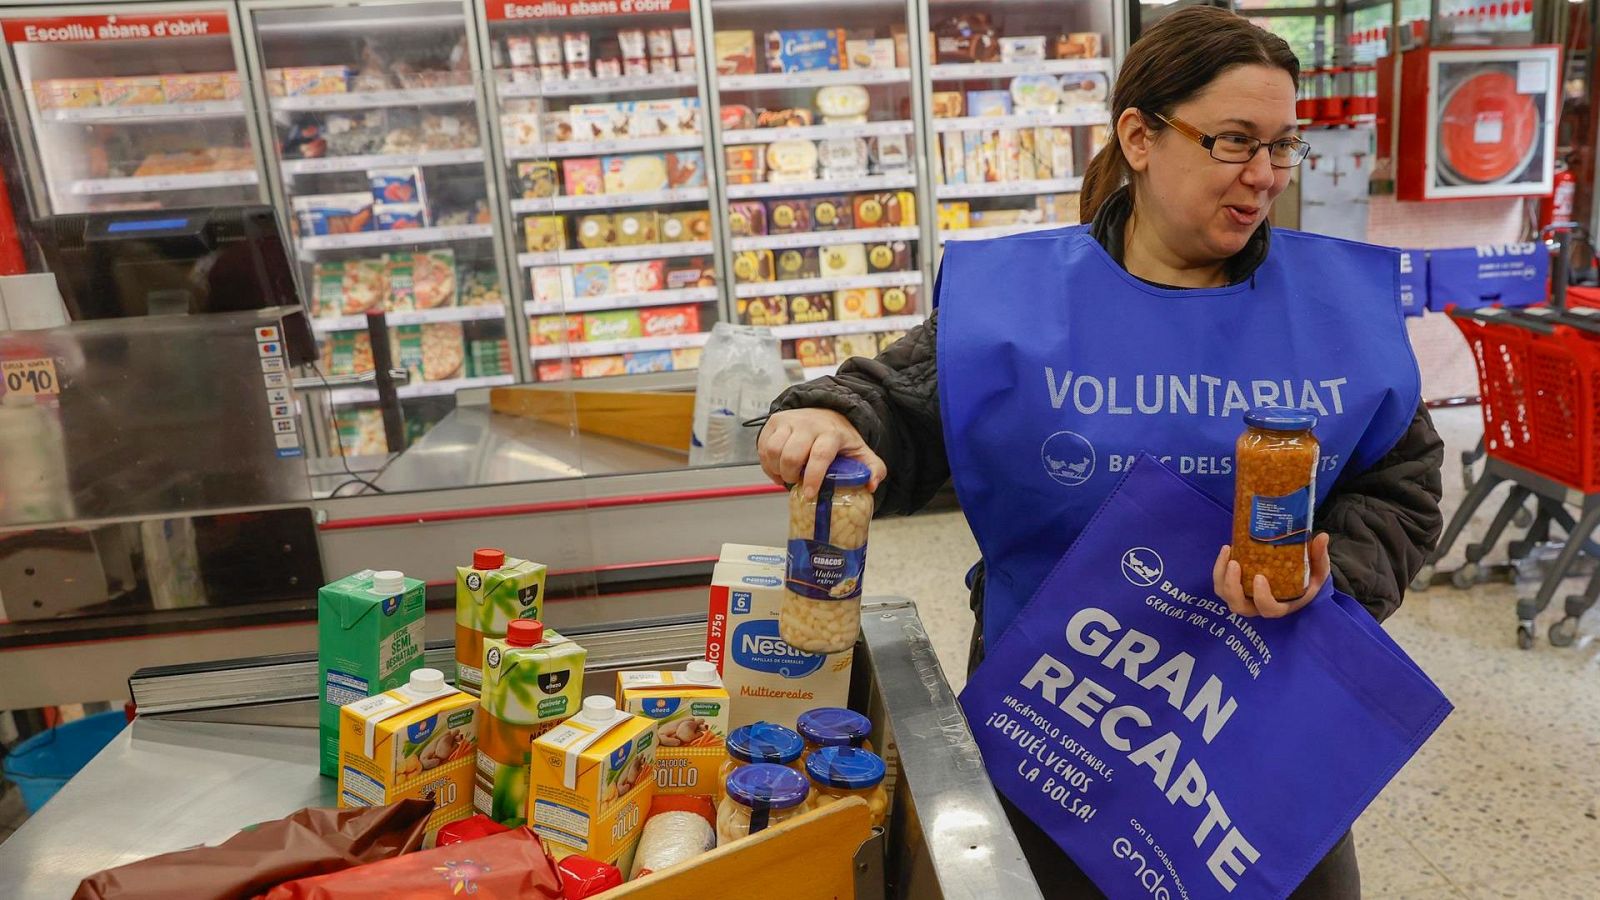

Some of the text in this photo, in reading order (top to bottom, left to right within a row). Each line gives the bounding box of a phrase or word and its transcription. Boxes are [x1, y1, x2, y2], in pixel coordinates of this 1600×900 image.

[504, 3, 567, 19] Escolliu
[570, 1, 618, 16] abans
[24, 19, 209, 41] Escolliu abans d'obrir
[1044, 366, 1348, 417] VOLUNTARIAT
[1109, 454, 1232, 475] BAC DELS
[813, 556, 842, 566] CIDACOS
[737, 597, 746, 608] 6
[1145, 595, 1188, 620] GRACIAS
[1187, 612, 1209, 628] POR
[1209, 622, 1226, 638] LA
[711, 614, 725, 638] 375g
[1159, 580, 1272, 665] BANC DELS ALIMENTS
[385, 643, 419, 671] DESNATADA
[391, 633, 411, 655] SEMI
[1064, 606, 1239, 746] GRAN
[740, 685, 814, 700] Multicereales
[985, 711, 1093, 794] ¡DEVUÉLVENOS
[1002, 695, 1114, 783] HAGÁMOSLO SOSTENIBLE,
[1019, 652, 1261, 893] RECAPTE
[1018, 759, 1098, 823] LA BOLSA!
[611, 805, 639, 846] POLLO
[1130, 818, 1146, 836] con
[1145, 833, 1155, 846] la
